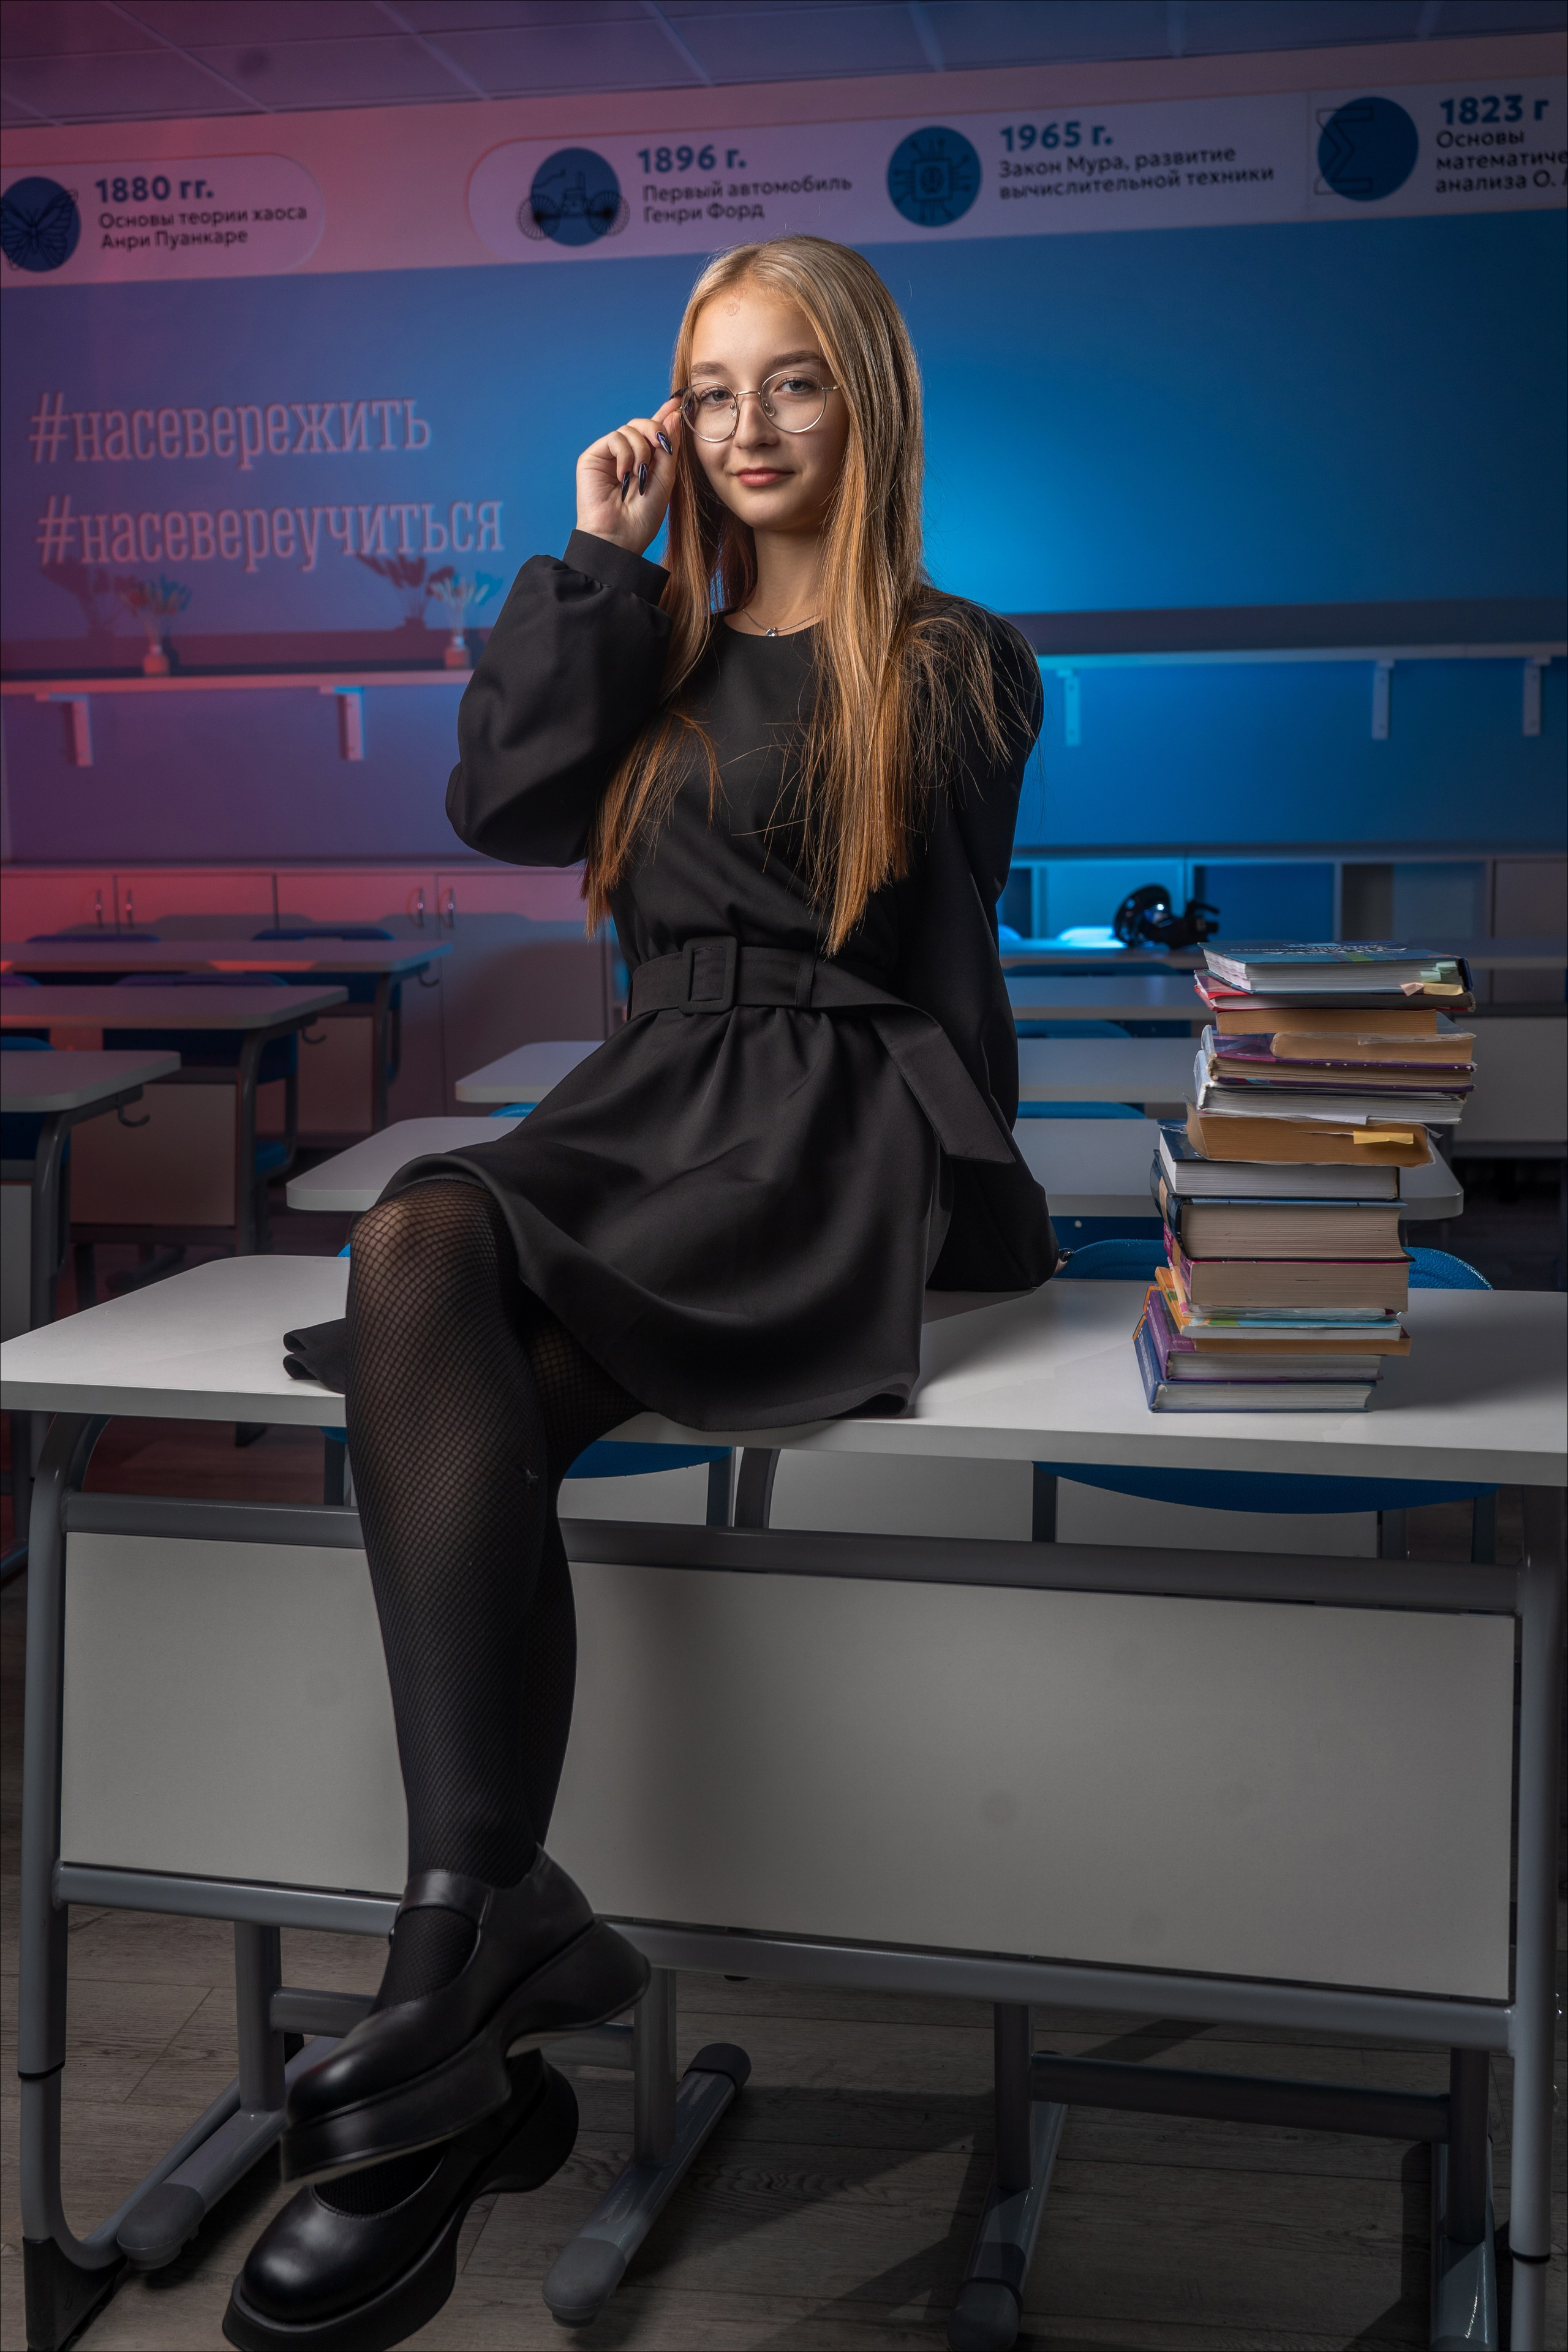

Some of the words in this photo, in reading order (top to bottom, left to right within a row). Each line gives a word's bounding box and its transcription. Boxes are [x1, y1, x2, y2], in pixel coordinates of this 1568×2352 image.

[1441, 95, 1523, 126] 1823
[1000, 121, 1082, 152] 1965
[1092, 126, 1114, 146] г.
[1436, 130, 1525, 149] Основы
[638, 144, 717, 174] 1896
[726, 149, 747, 169] г.
[999, 160, 1062, 178] Закон
[1067, 155, 1131, 175] Мура,
[1136, 147, 1237, 170] развитие
[95, 175, 172, 203] 1880
[179, 179, 214, 200] гг.
[643, 181, 723, 204] Первый
[728, 175, 853, 198] автомобиль
[1000, 170, 1182, 200] вычислительной
[1186, 167, 1275, 187] техники
[1436, 175, 1528, 194] анализа
[1533, 169, 1556, 187] О.
[99, 211, 175, 229] Основы
[179, 209, 247, 227] теории
[252, 206, 307, 222] хаоса
[644, 205, 703, 225] Генри
[707, 202, 764, 221] Форд
[101, 232, 151, 251] Анри
[155, 229, 248, 250] Пуанкаре
[28, 392, 431, 470] #насевережить
[36, 495, 505, 573] #насевереучиться
